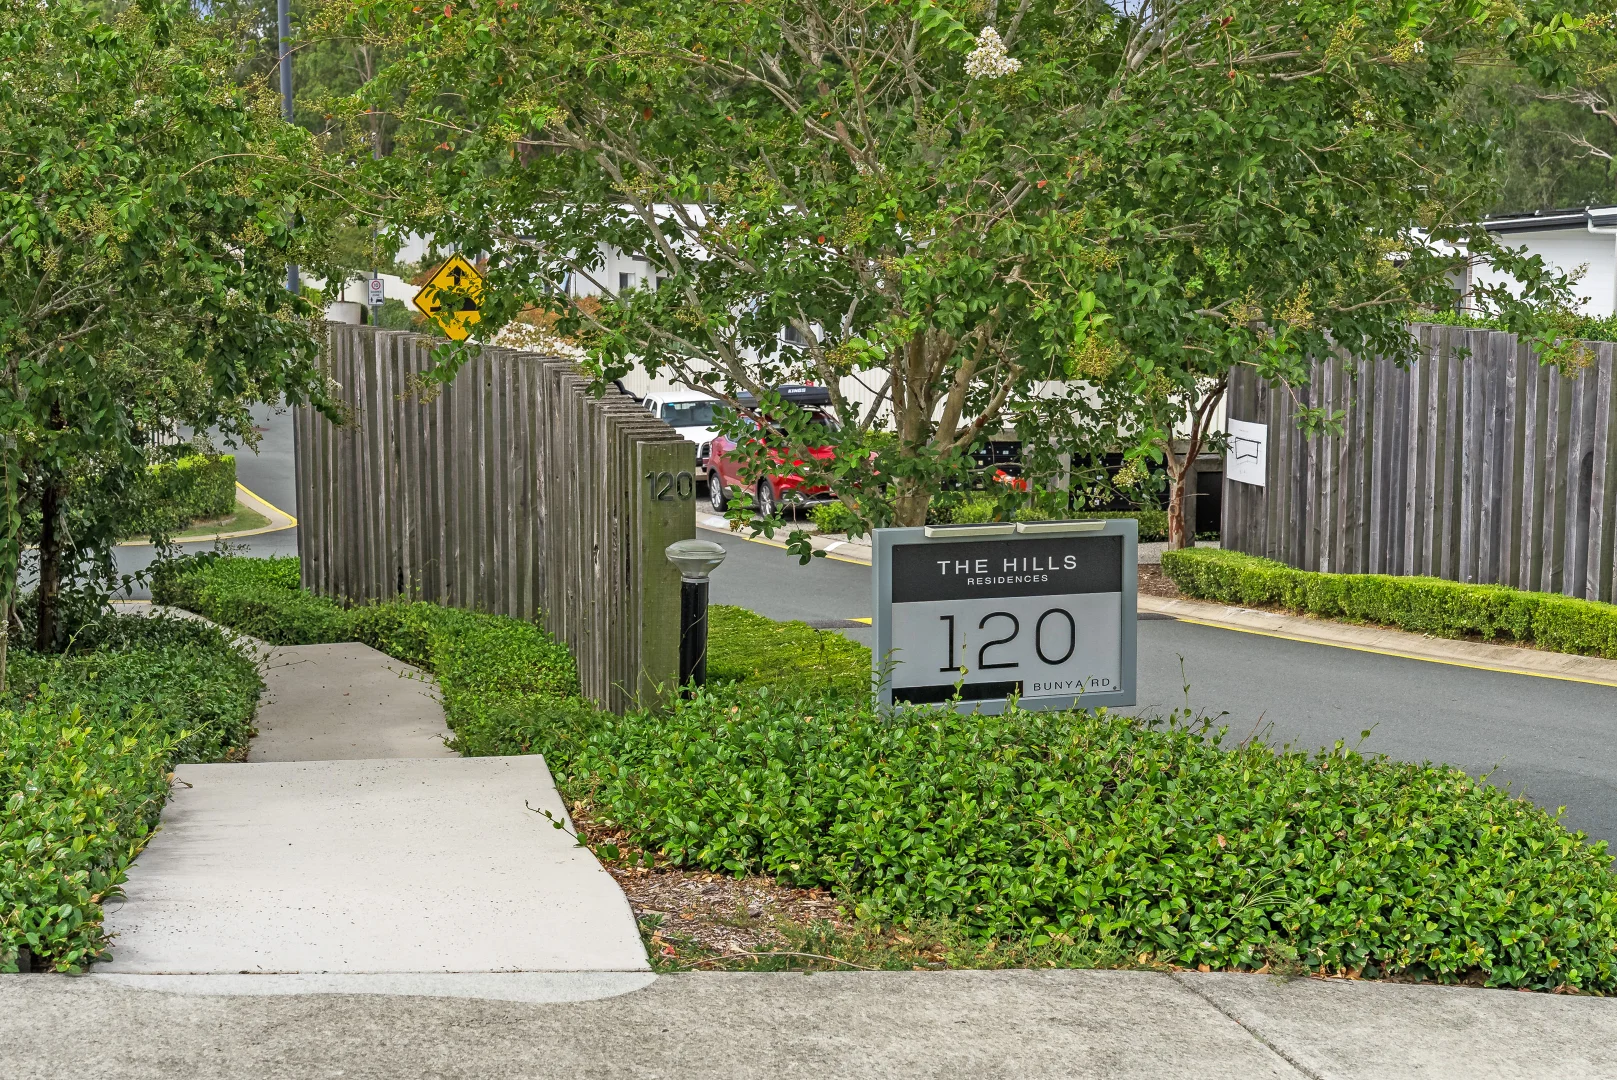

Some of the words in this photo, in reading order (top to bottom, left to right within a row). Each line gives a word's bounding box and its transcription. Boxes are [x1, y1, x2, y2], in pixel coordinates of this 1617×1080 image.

[645, 471, 693, 501] 120
[937, 559, 988, 575] THE
[1003, 555, 1077, 573] HILLS
[967, 574, 1048, 586] RESIDENCES
[939, 608, 1076, 673] 120
[1033, 680, 1083, 692] BUNYA
[1091, 678, 1110, 688] RD
